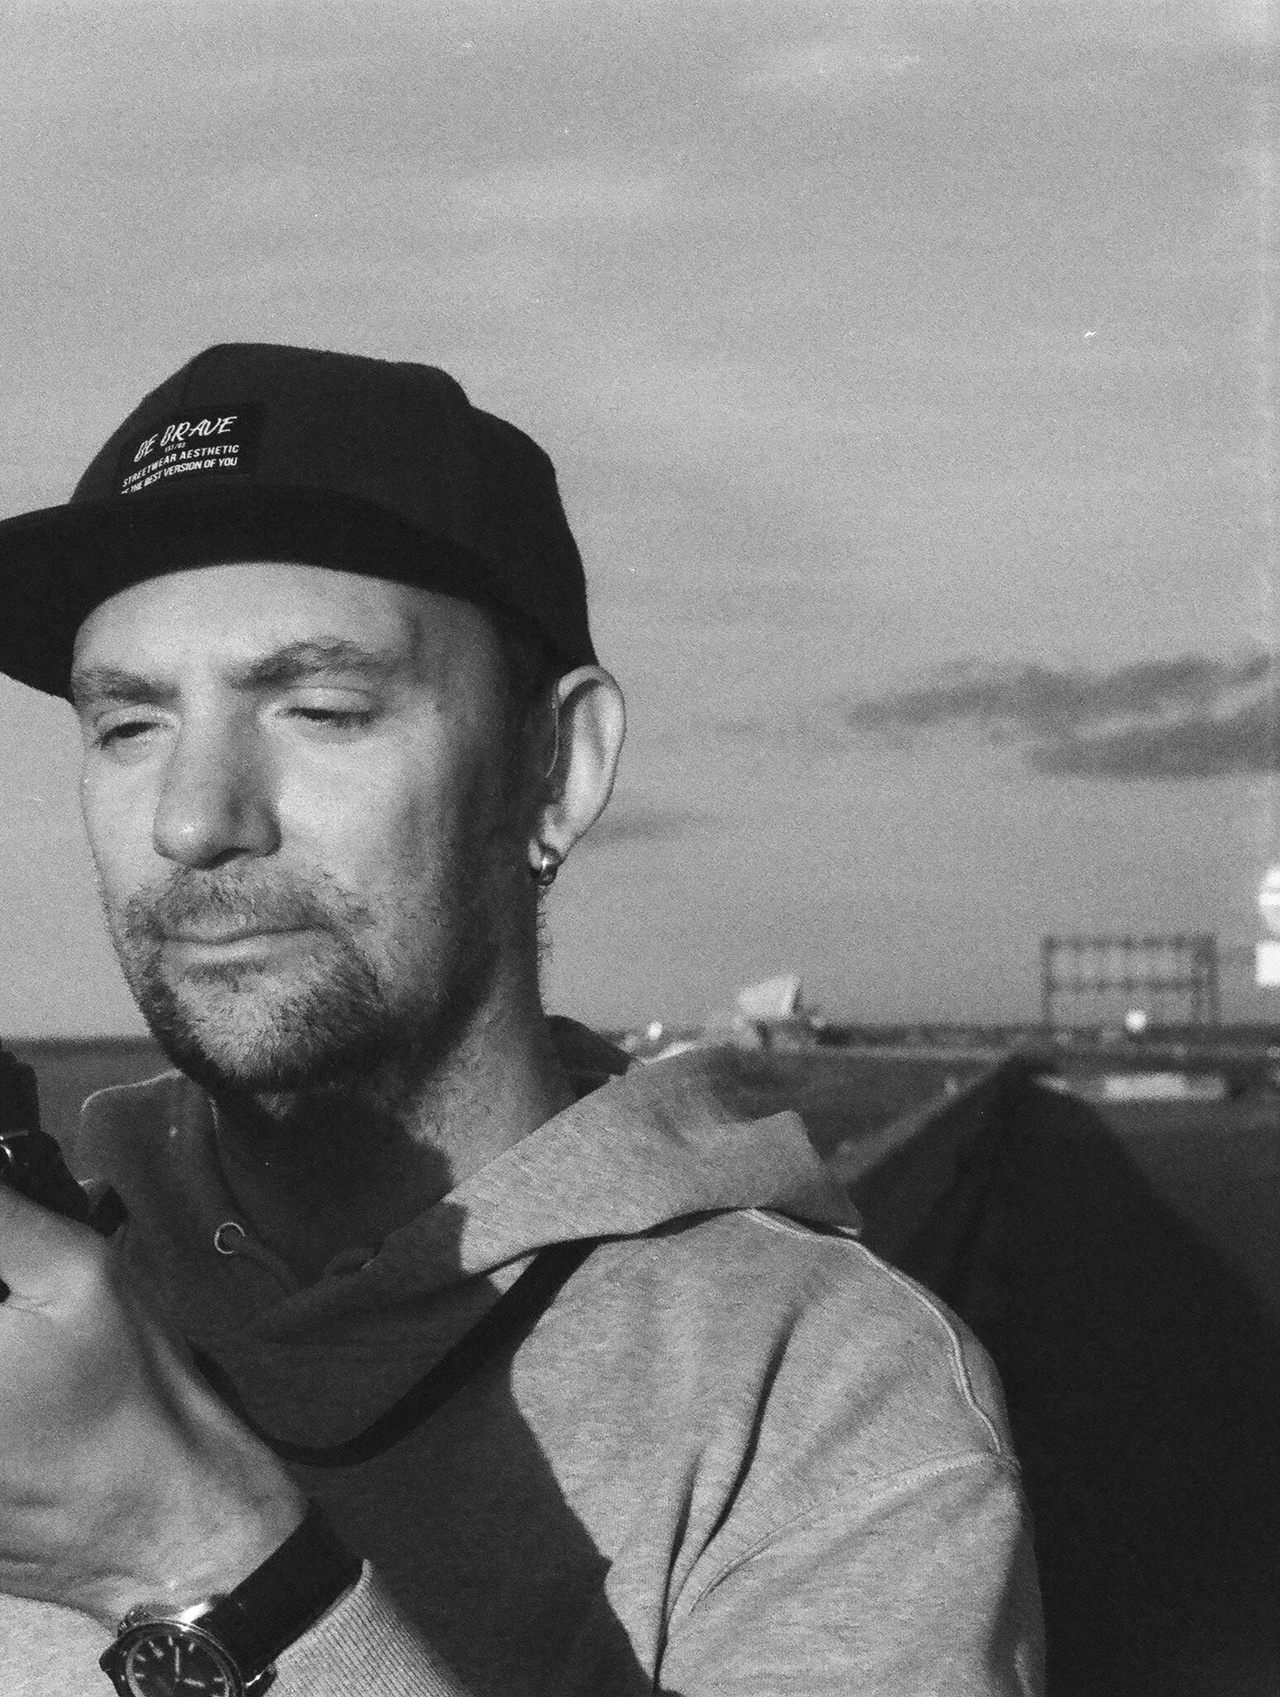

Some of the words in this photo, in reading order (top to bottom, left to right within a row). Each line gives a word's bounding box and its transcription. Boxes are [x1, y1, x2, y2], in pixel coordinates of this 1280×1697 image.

[133, 433, 159, 463] BE
[160, 416, 238, 447] BRAVE
[122, 453, 177, 488] STREETWEAR
[179, 444, 240, 461] AESTHETIC
[130, 479, 144, 493] THE
[143, 469, 163, 487] BEST
[163, 460, 203, 477] VERSION
[203, 458, 217, 470] OF
[218, 456, 239, 468] YOU
